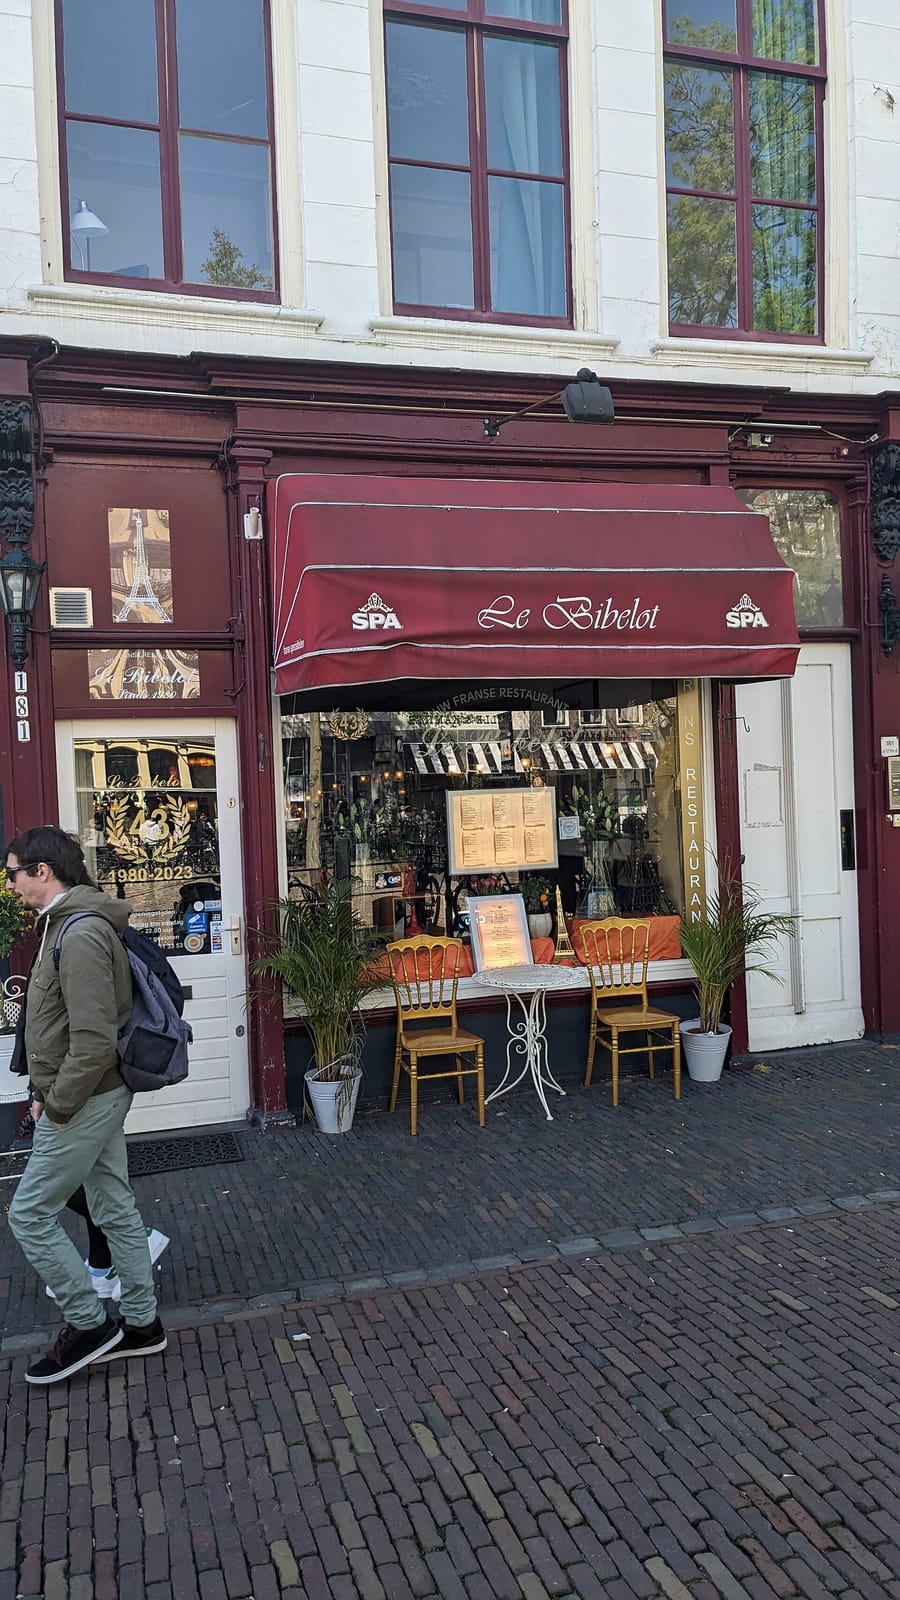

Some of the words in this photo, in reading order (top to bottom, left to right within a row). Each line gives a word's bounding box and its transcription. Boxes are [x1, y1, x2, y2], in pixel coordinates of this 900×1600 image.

[351, 612, 402, 630] SPA
[477, 595, 531, 629] Le
[542, 595, 661, 630] Bibelot
[725, 611, 769, 628] SPA
[16, 673, 29, 740] 181
[453, 687, 497, 707] FRANSE
[499, 687, 570, 711] RESTAURANT
[339, 714, 359, 731] 43
[129, 774, 180, 788] Bbelo
[129, 808, 170, 840] 43
[686, 768, 702, 924] RESTAURAN
[108, 865, 193, 883] 1980-2023
